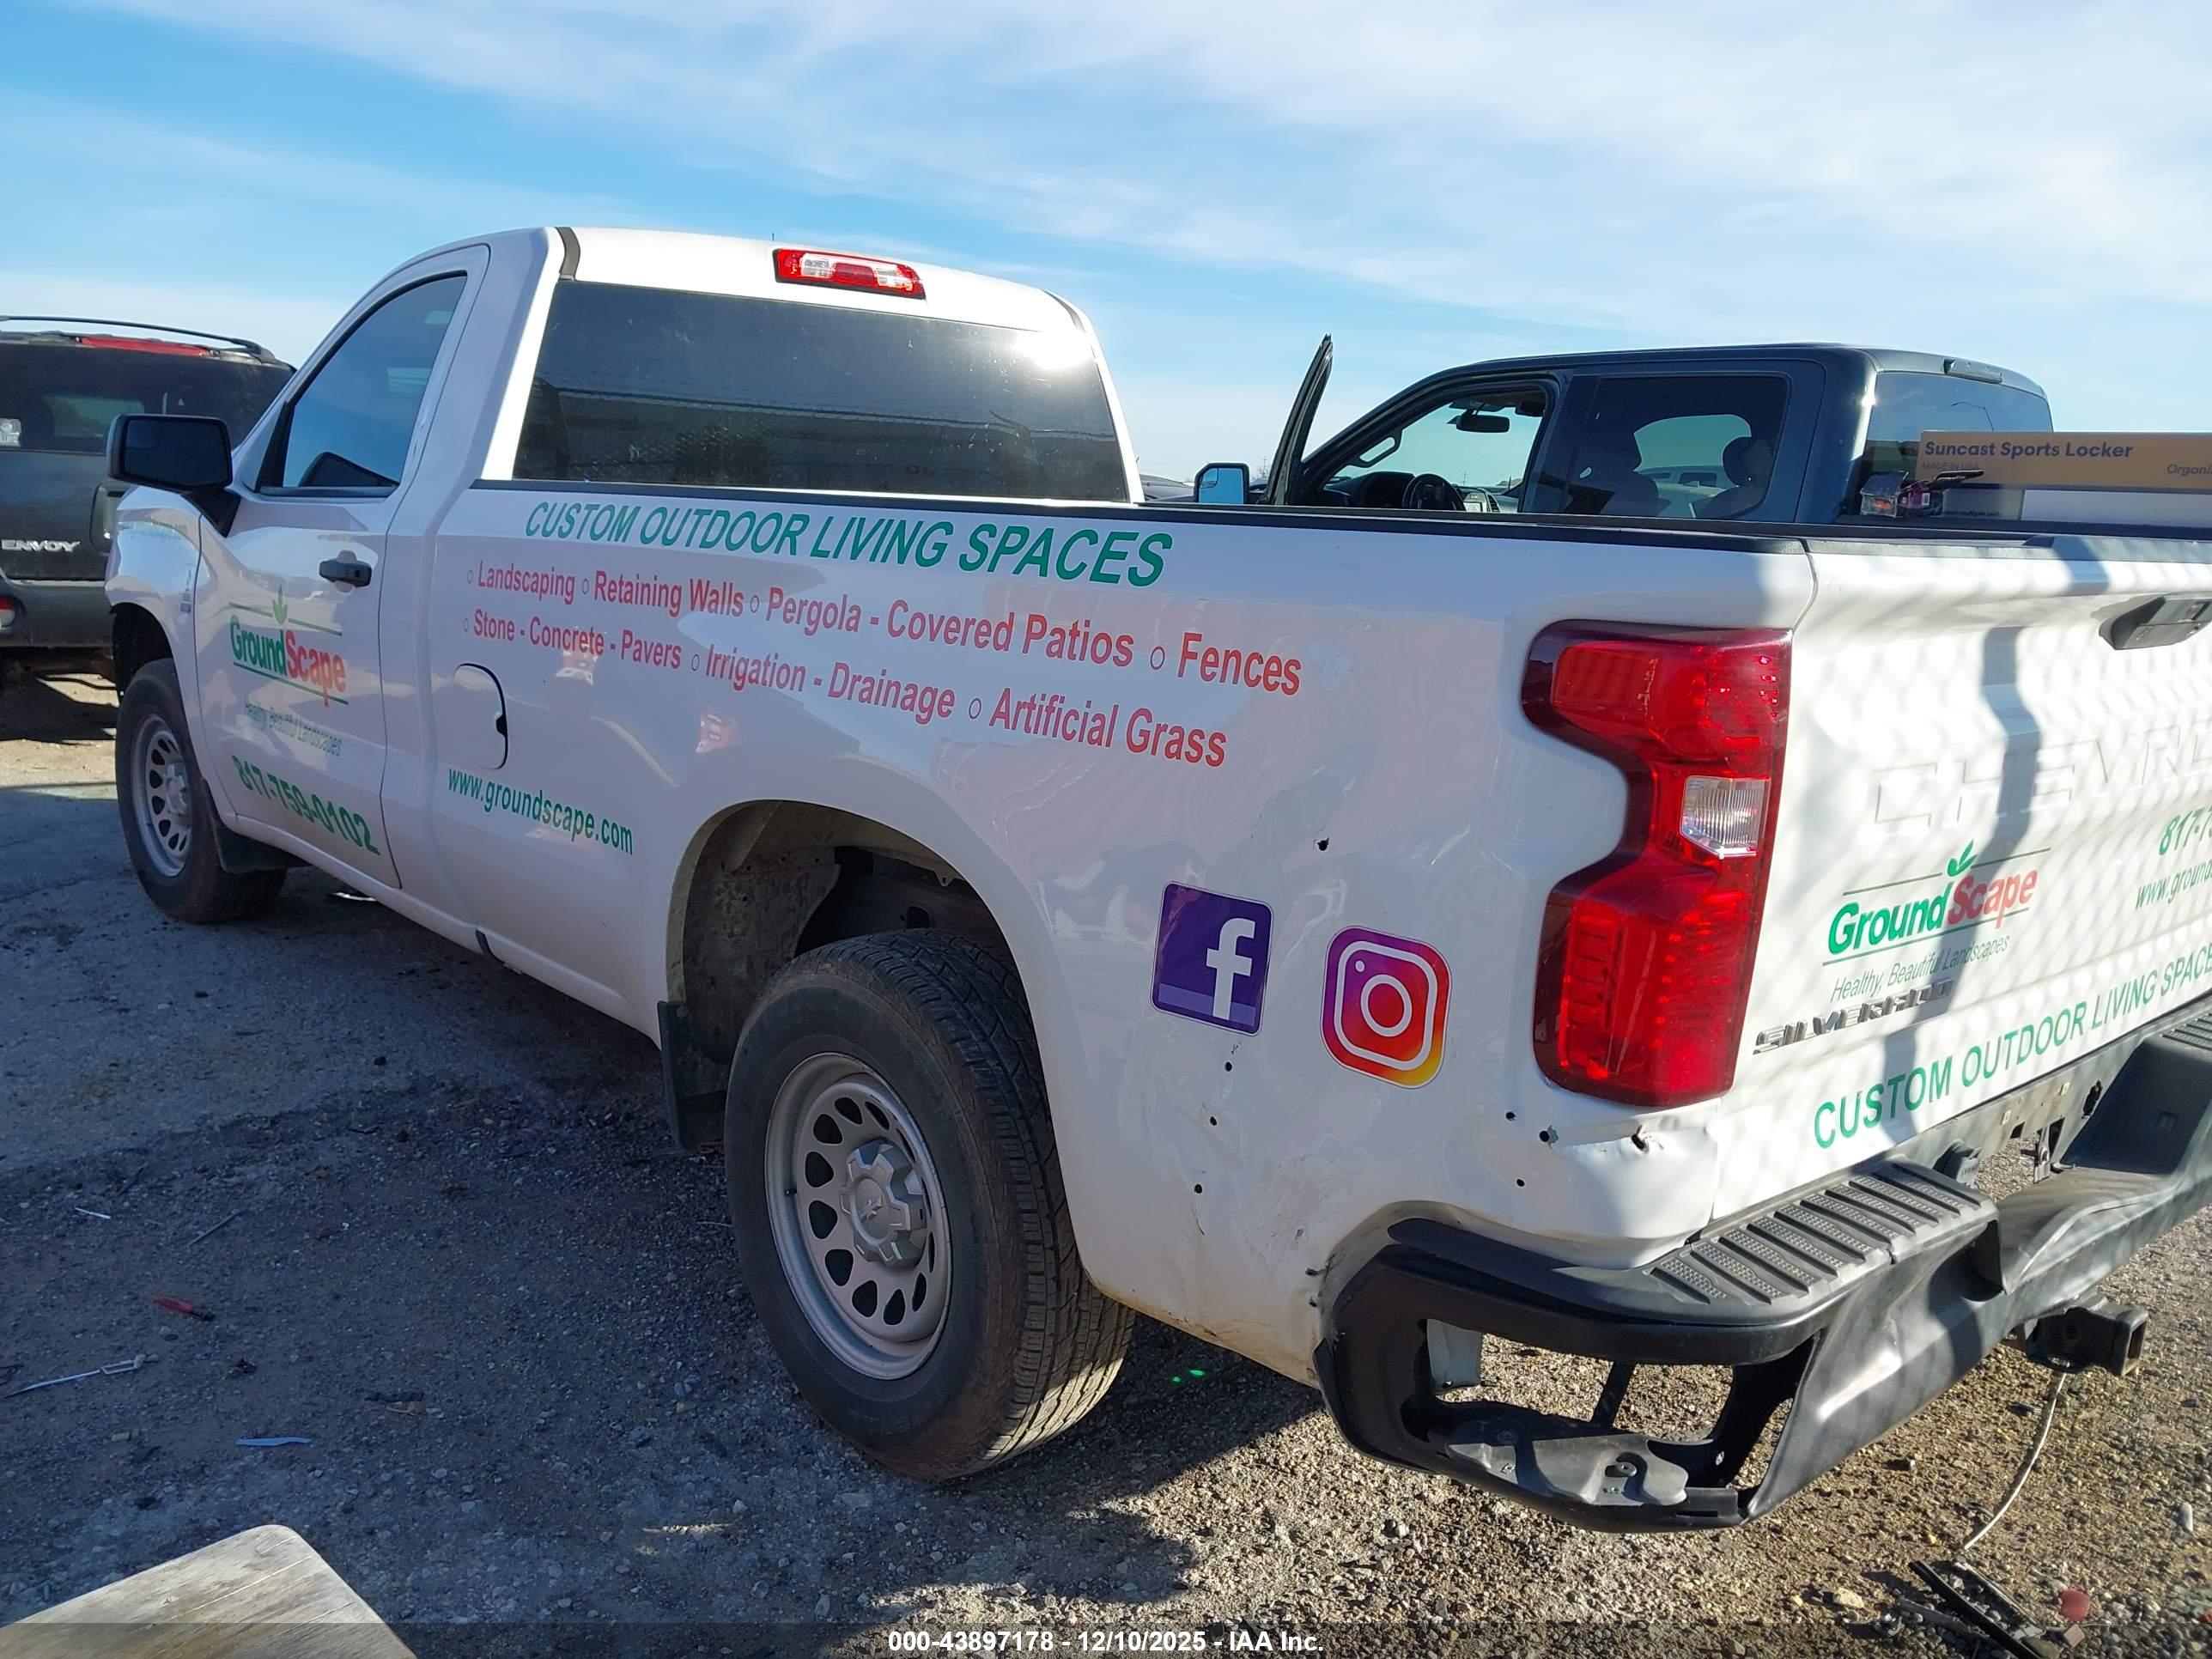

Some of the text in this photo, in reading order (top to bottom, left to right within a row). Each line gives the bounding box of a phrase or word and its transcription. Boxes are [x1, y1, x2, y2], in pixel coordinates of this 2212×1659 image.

[1924, 441, 2133, 459] Suncast Sports Locker
[1, 539, 81, 552] ENVOY
[526, 501, 1173, 586] CUSTOM OUTDOOR LIVING SPACES
[230, 615, 347, 707] GroundScape
[477, 561, 575, 605] Landscaping
[594, 570, 682, 617] Retaining
[690, 579, 744, 617] Walls
[765, 587, 861, 636] Pergola
[887, 599, 1015, 653] Covered
[1022, 613, 1134, 667] Patios
[1177, 632, 1302, 696] Fences
[473, 608, 515, 641] Stone
[529, 617, 605, 655] Concrete
[621, 629, 681, 670] Pavers
[706, 644, 805, 692] Irrigation
[828, 661, 956, 726] Drainage
[989, 688, 1120, 748] Artificial
[1126, 707, 1227, 767] Grass
[232, 755, 381, 856] 817-759-0102
[448, 769, 634, 855] www.groundscape.com
[1828, 871, 2038, 955] GroundScape
[1830, 934, 2010, 1003] Healthy, Beautiful Landscapes
[1753, 977, 1953, 1055] SILVERADO
[1814, 1056, 1954, 1149] CUSTOM
[1961, 1001, 2087, 1087] OUTDOOR
[2092, 969, 2157, 1029] LIVING
